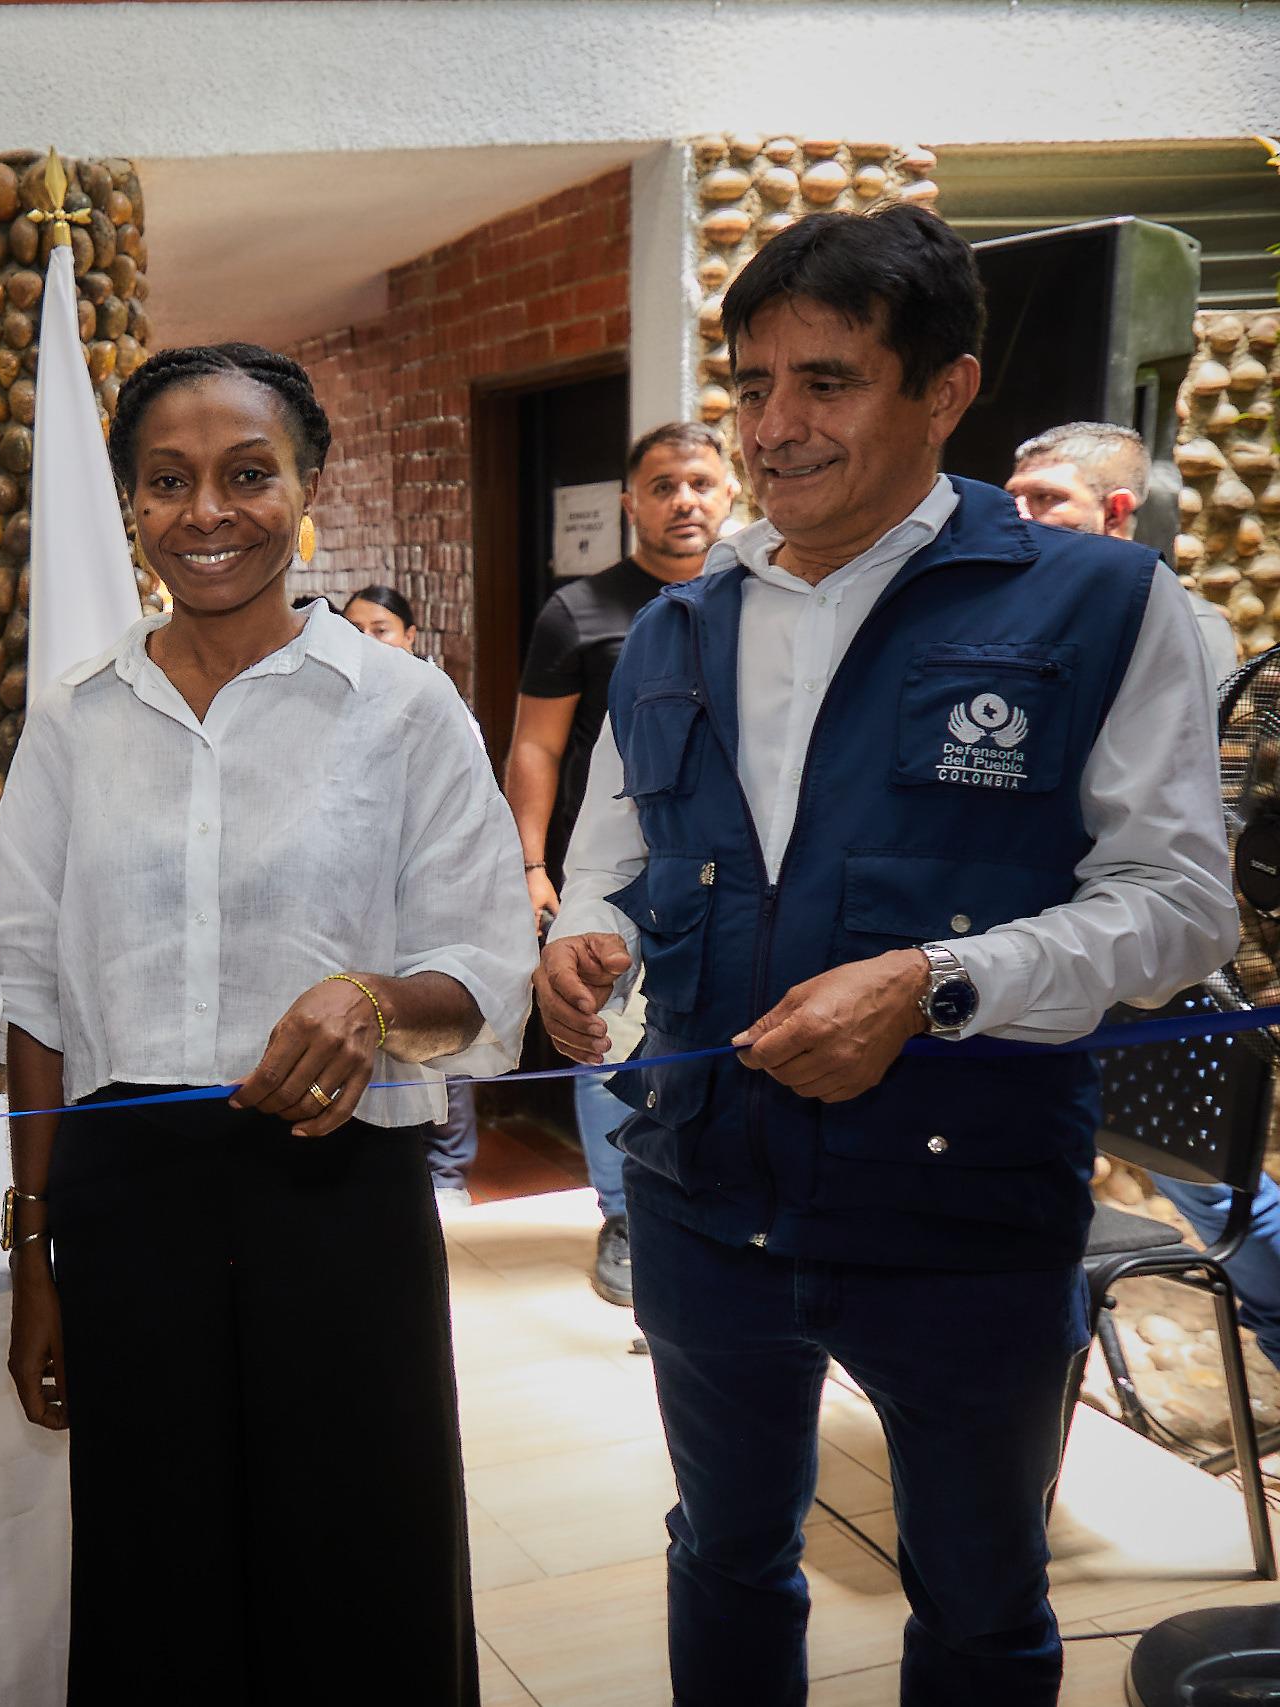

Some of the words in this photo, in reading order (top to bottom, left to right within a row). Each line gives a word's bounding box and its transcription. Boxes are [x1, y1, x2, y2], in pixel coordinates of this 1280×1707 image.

[943, 754, 966, 766] del
[973, 757, 1023, 773] Pueblo
[938, 769, 1019, 789] COLOMBIA
